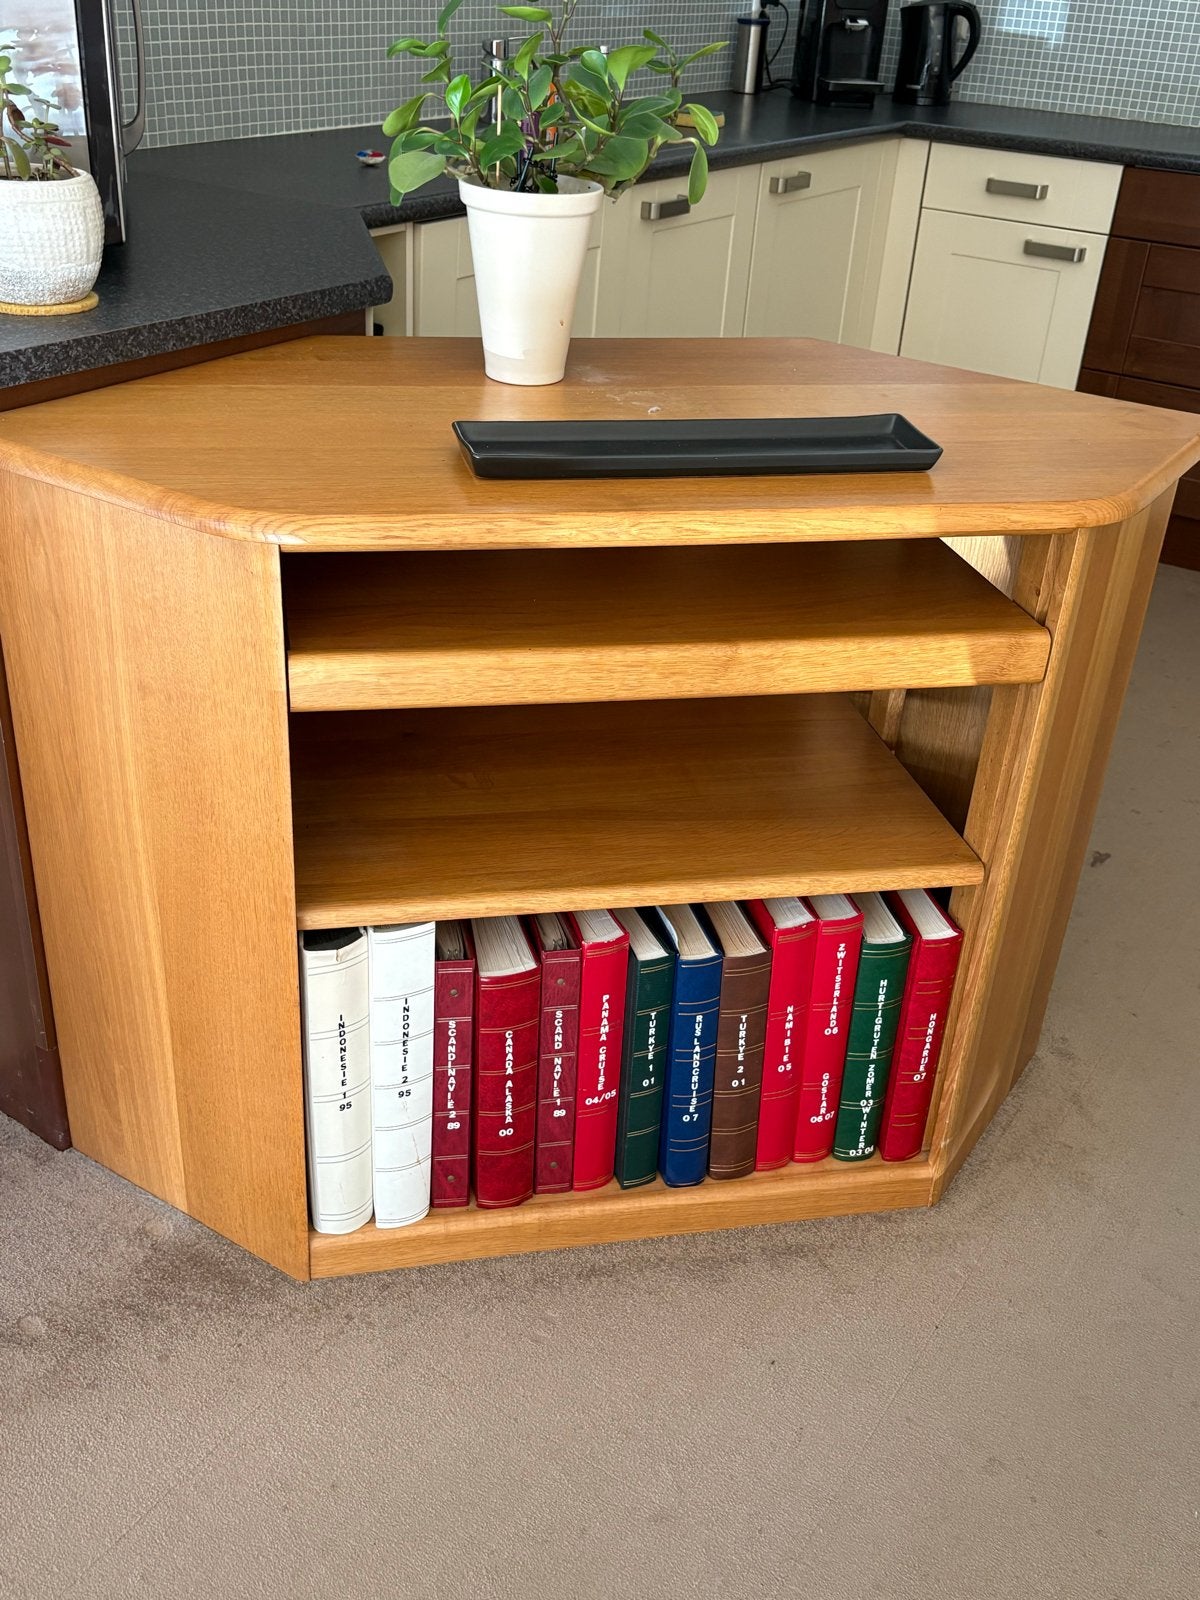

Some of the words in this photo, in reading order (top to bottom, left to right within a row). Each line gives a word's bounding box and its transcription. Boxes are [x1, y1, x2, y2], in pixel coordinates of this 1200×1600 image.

[829, 943, 846, 1028] ZWITSERLAND
[600, 995, 610, 1041] PANAMA
[782, 1006, 793, 1062] NAMIBIE
[824, 1027, 838, 1036] 06
[870, 980, 887, 1059] HURTIGRUTEN
[338, 1014, 347, 1087] INDONESIE
[401, 998, 409, 1072] INDONESIE
[648, 1013, 656, 1060] TURKYE
[738, 1015, 747, 1061] TURKYE
[919, 1013, 937, 1072] HONGARIJE
[447, 1021, 456, 1109] SCANDINAVIË
[504, 1031, 514, 1075] CANADA
[597, 1046, 607, 1091] CRUISE
[777, 1063, 792, 1073] 05
[397, 1089, 411, 1098] 95
[642, 1077, 655, 1087] 01
[731, 1079, 746, 1088] 01
[820, 1073, 829, 1114] GOSLAR
[865, 1064, 875, 1097] ZOMER
[913, 1072, 927, 1082] 07
[339, 1101, 352, 1111] 95
[504, 1080, 513, 1124] ALASKA
[553, 1109, 566, 1118] 89
[585, 1089, 617, 1106] 04/05
[860, 1099, 873, 1107] 03
[447, 1122, 460, 1130] 89
[498, 1127, 513, 1136] 00
[682, 1114, 699, 1122] 07
[810, 1114, 824, 1124] 06
[824, 1111, 835, 1120] 07
[858, 1107, 870, 1149] WINTER
[849, 1149, 862, 1157] 03
